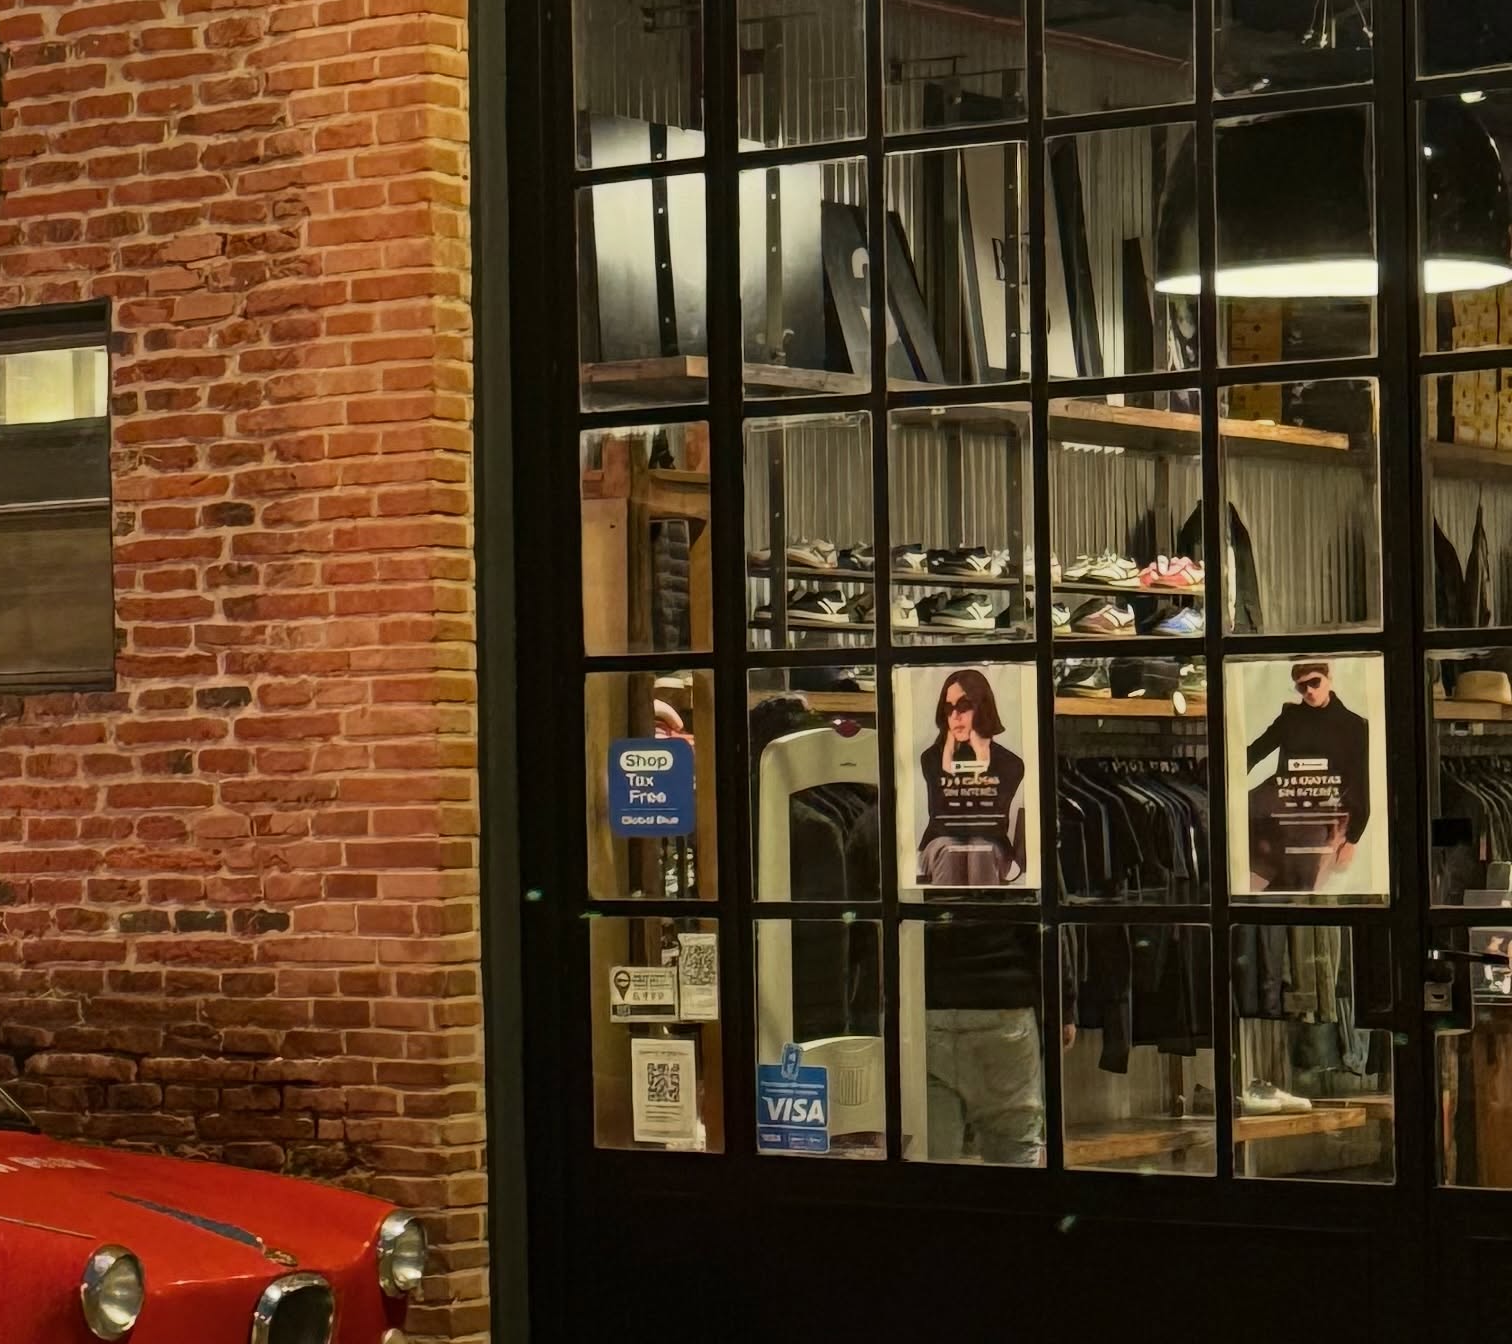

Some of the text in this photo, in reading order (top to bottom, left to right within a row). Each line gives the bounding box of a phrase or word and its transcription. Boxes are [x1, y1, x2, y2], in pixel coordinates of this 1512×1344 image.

[625, 754, 668, 769] Shop
[625, 773, 654, 787] Tax
[629, 789, 667, 805] Free
[761, 1096, 825, 1125] VISA
